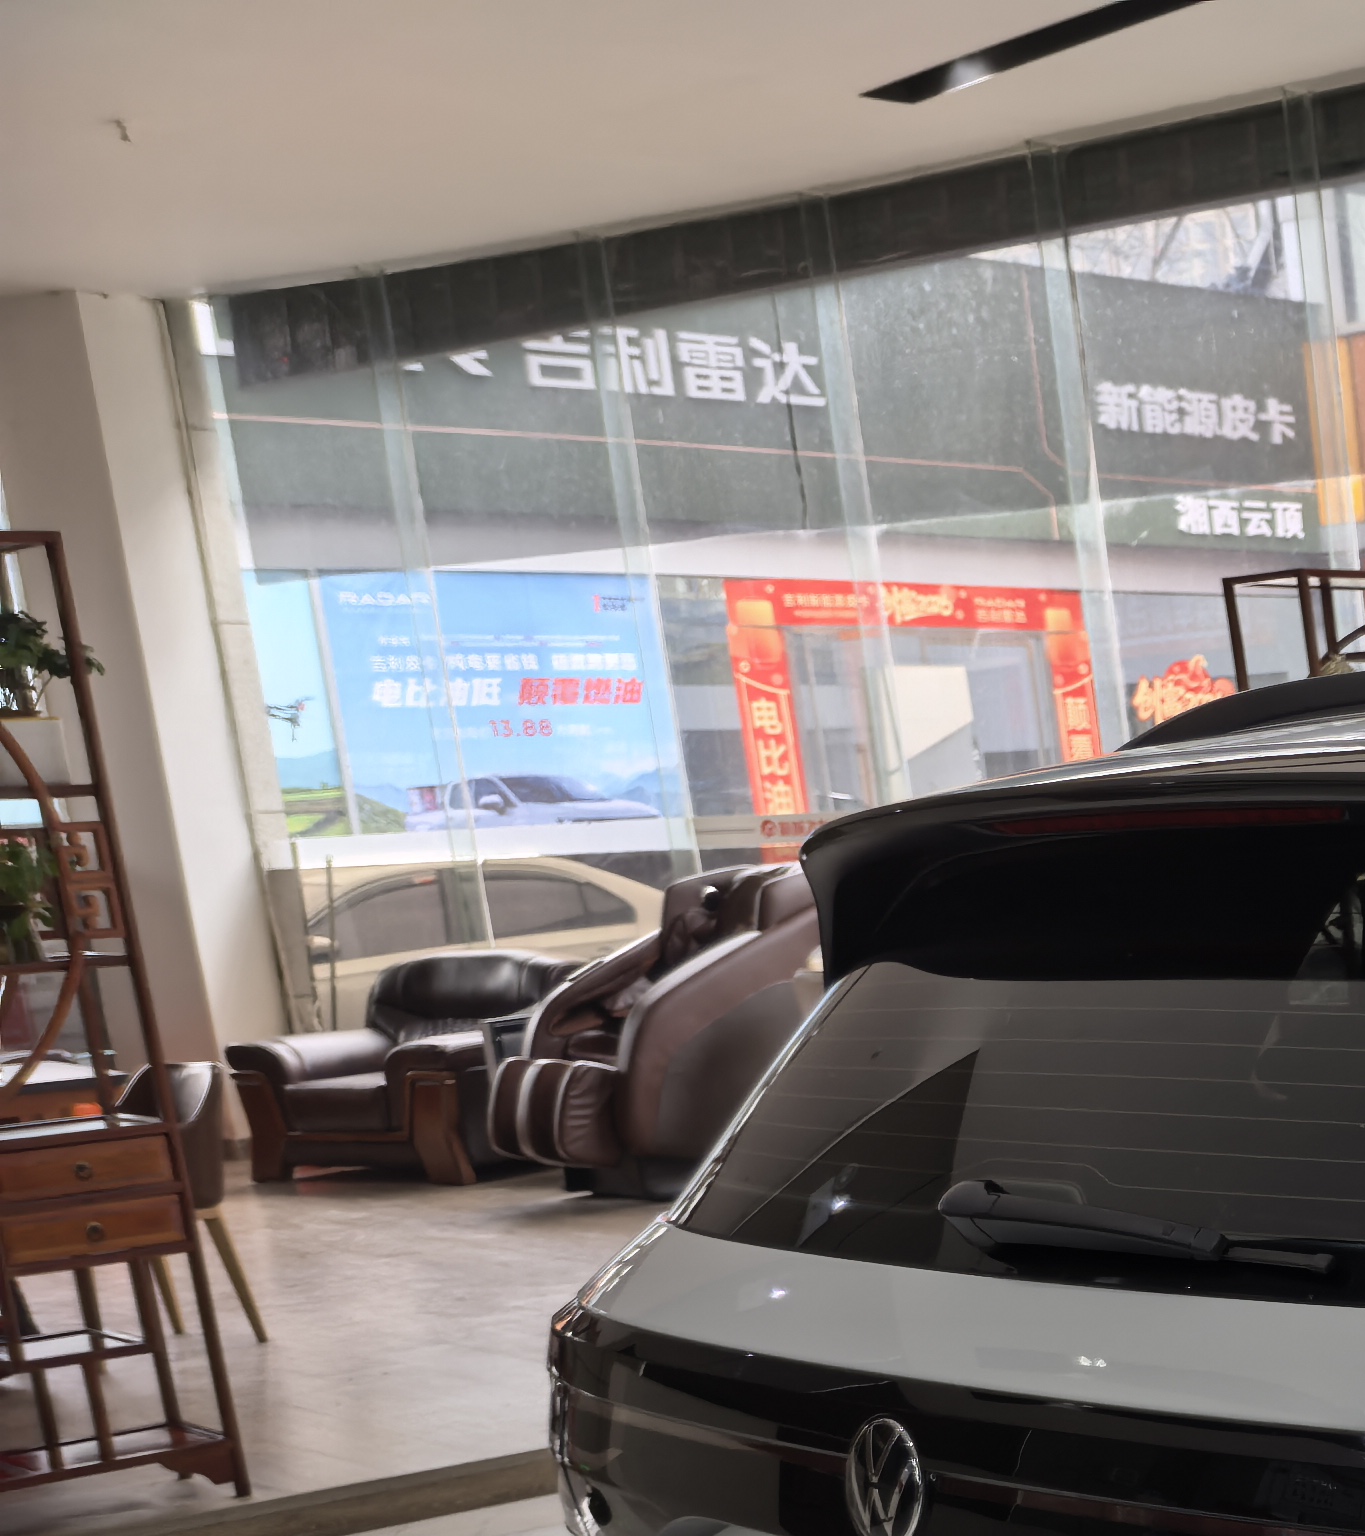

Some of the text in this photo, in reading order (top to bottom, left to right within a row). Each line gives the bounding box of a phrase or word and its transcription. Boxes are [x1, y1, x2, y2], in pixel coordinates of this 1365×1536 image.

[521, 326, 826, 407] 吉利雷达
[1096, 380, 1296, 444] 新能源皮卡
[1174, 494, 1305, 540] 湘西云顶
